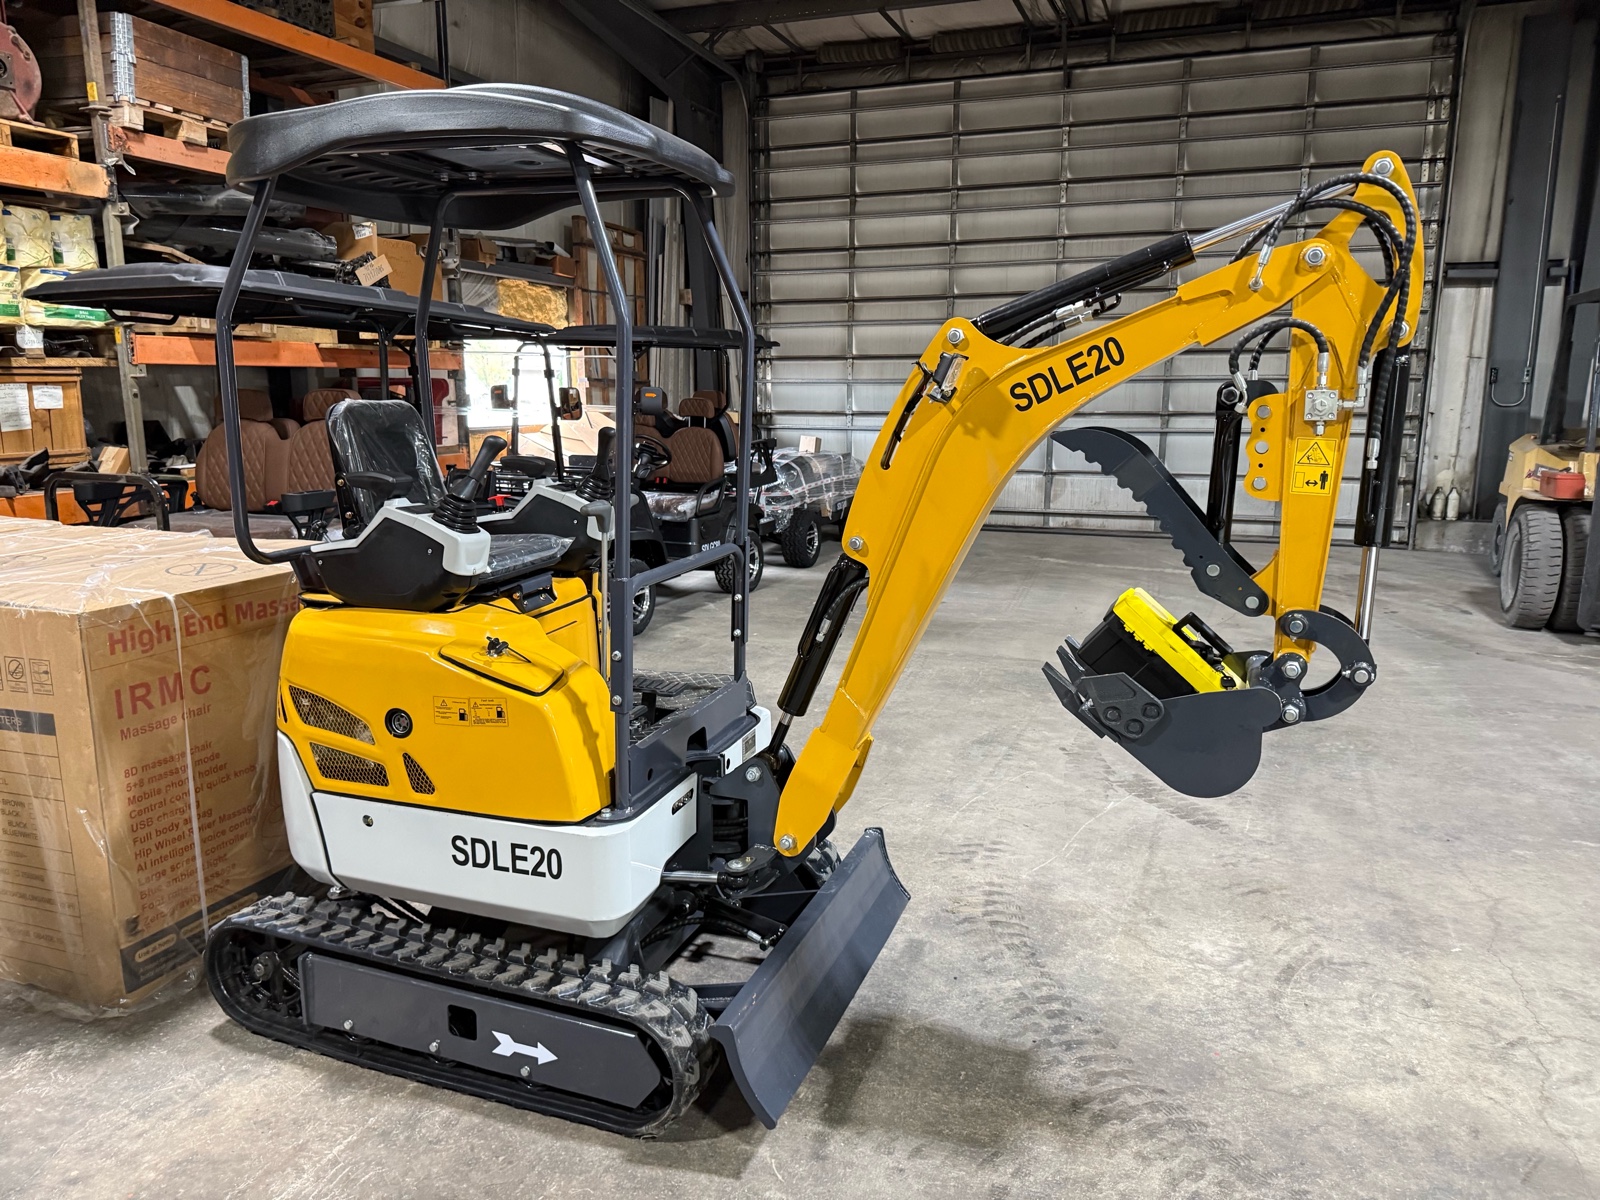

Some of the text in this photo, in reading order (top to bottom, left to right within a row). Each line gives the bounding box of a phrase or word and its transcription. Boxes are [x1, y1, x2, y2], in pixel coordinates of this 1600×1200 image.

[1009, 336, 1125, 412] SDLE20
[114, 665, 212, 720] IRMC
[119, 715, 178, 742] Massage
[123, 740, 213, 779] 8D massage chair
[126, 751, 221, 793] 5+8 massag mode
[127, 761, 228, 807] Mobile phon holder
[129, 799, 167, 820] Central
[169, 783, 204, 804] conol
[206, 774, 232, 792] quick
[130, 817, 154, 834] USB
[132, 807, 213, 848] Full body aibag
[134, 846, 152, 861] Hip
[154, 831, 186, 851] Wheel
[136, 862, 148, 874] AI
[150, 842, 197, 869] intelligen
[202, 829, 227, 845] voice
[170, 855, 196, 873] scree
[204, 831, 250, 857] controller
[451, 834, 563, 880] SDLE20
[165, 867, 206, 888] ambie
